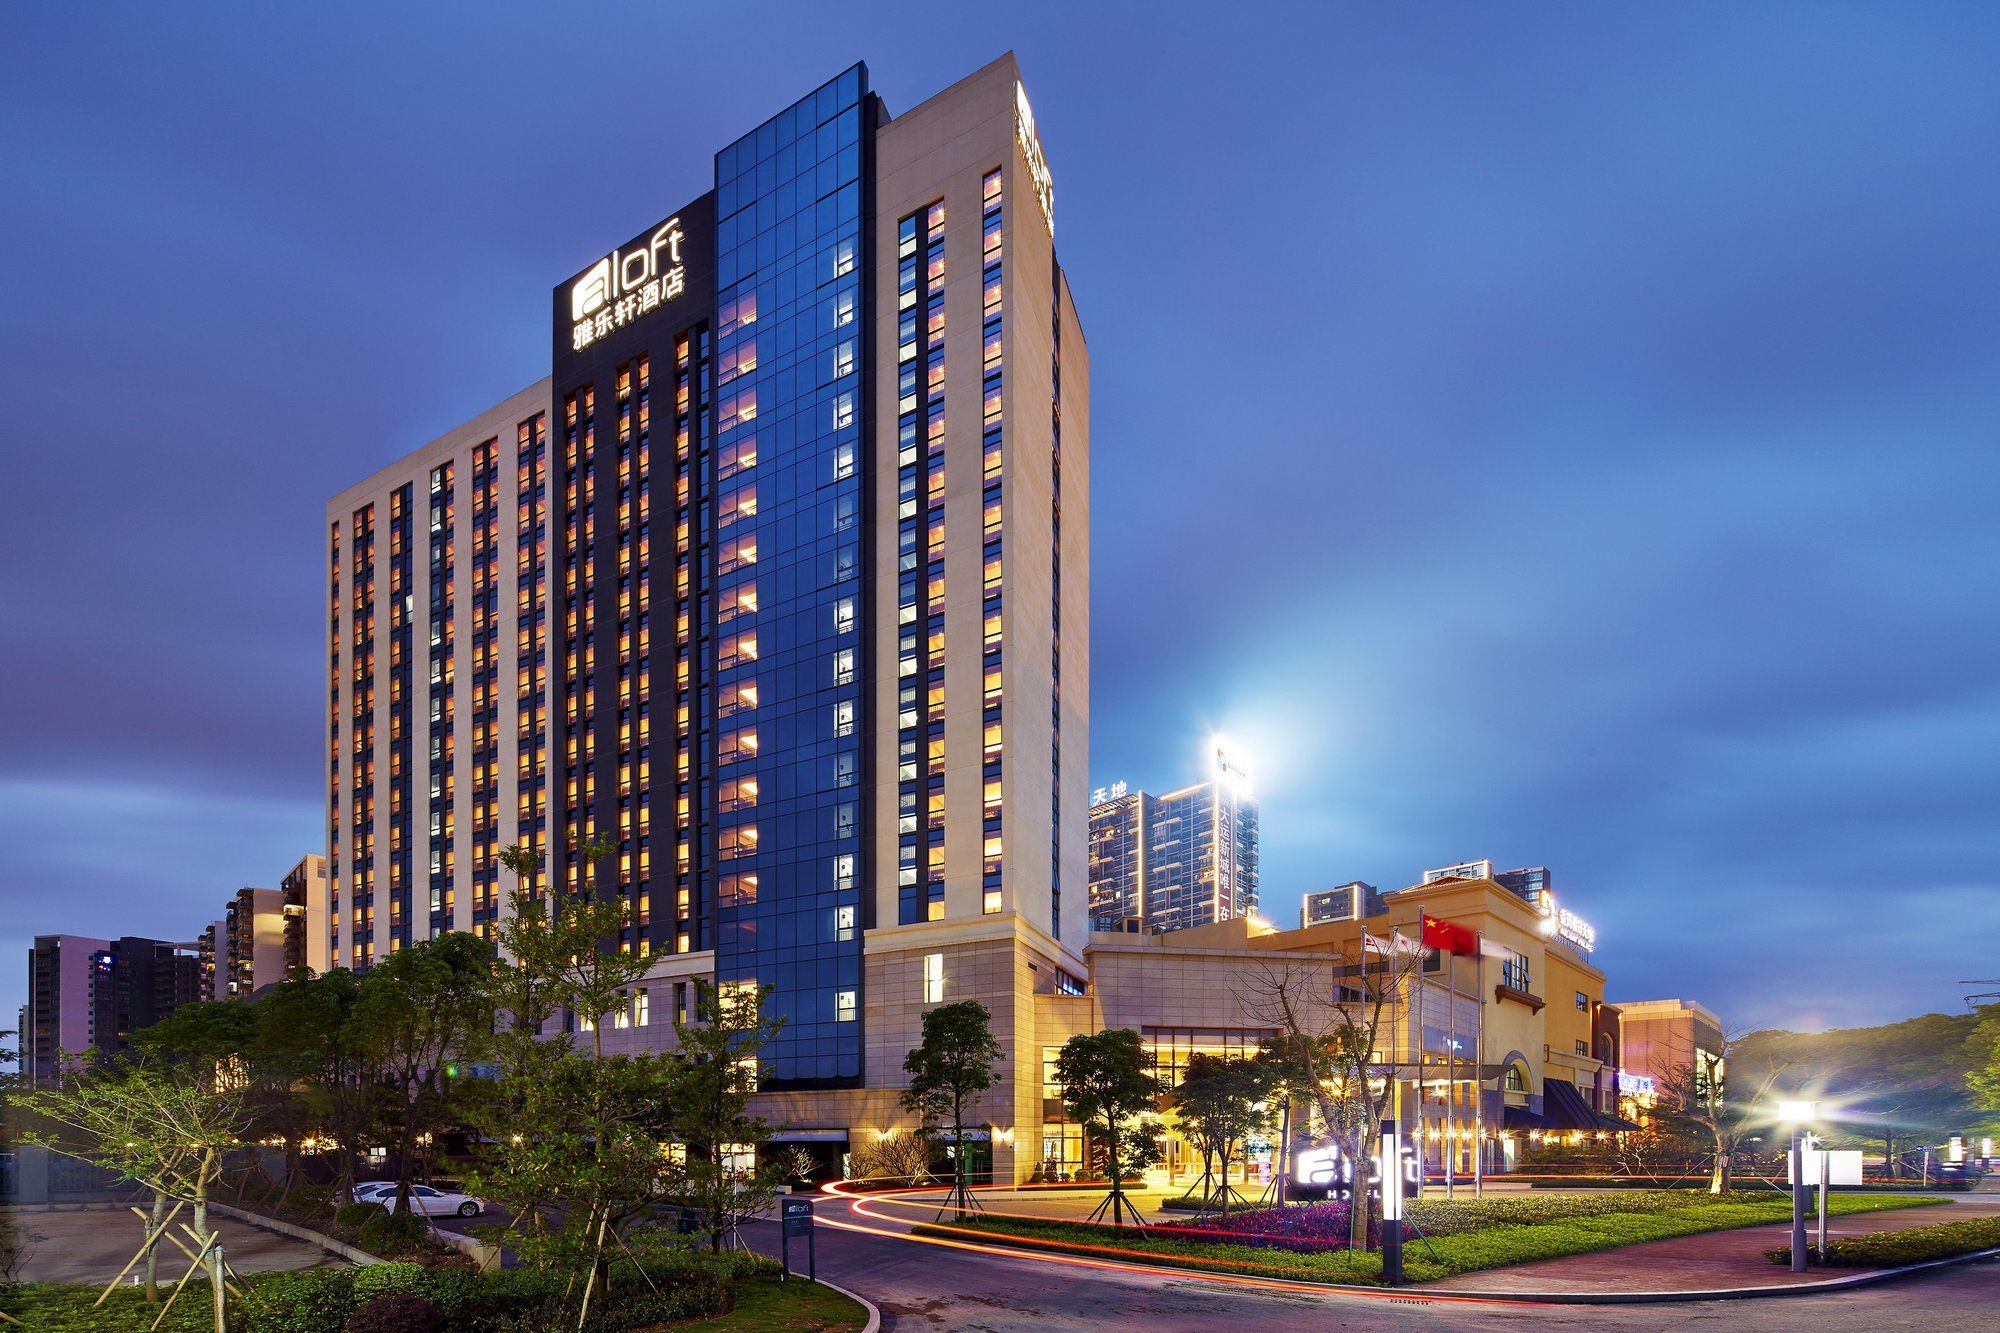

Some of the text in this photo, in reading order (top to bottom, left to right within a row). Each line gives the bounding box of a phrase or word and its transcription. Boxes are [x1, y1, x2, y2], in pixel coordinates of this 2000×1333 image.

[572, 217, 683, 322] aloft
[572, 265, 685, 351] 雅乐轩酒店
